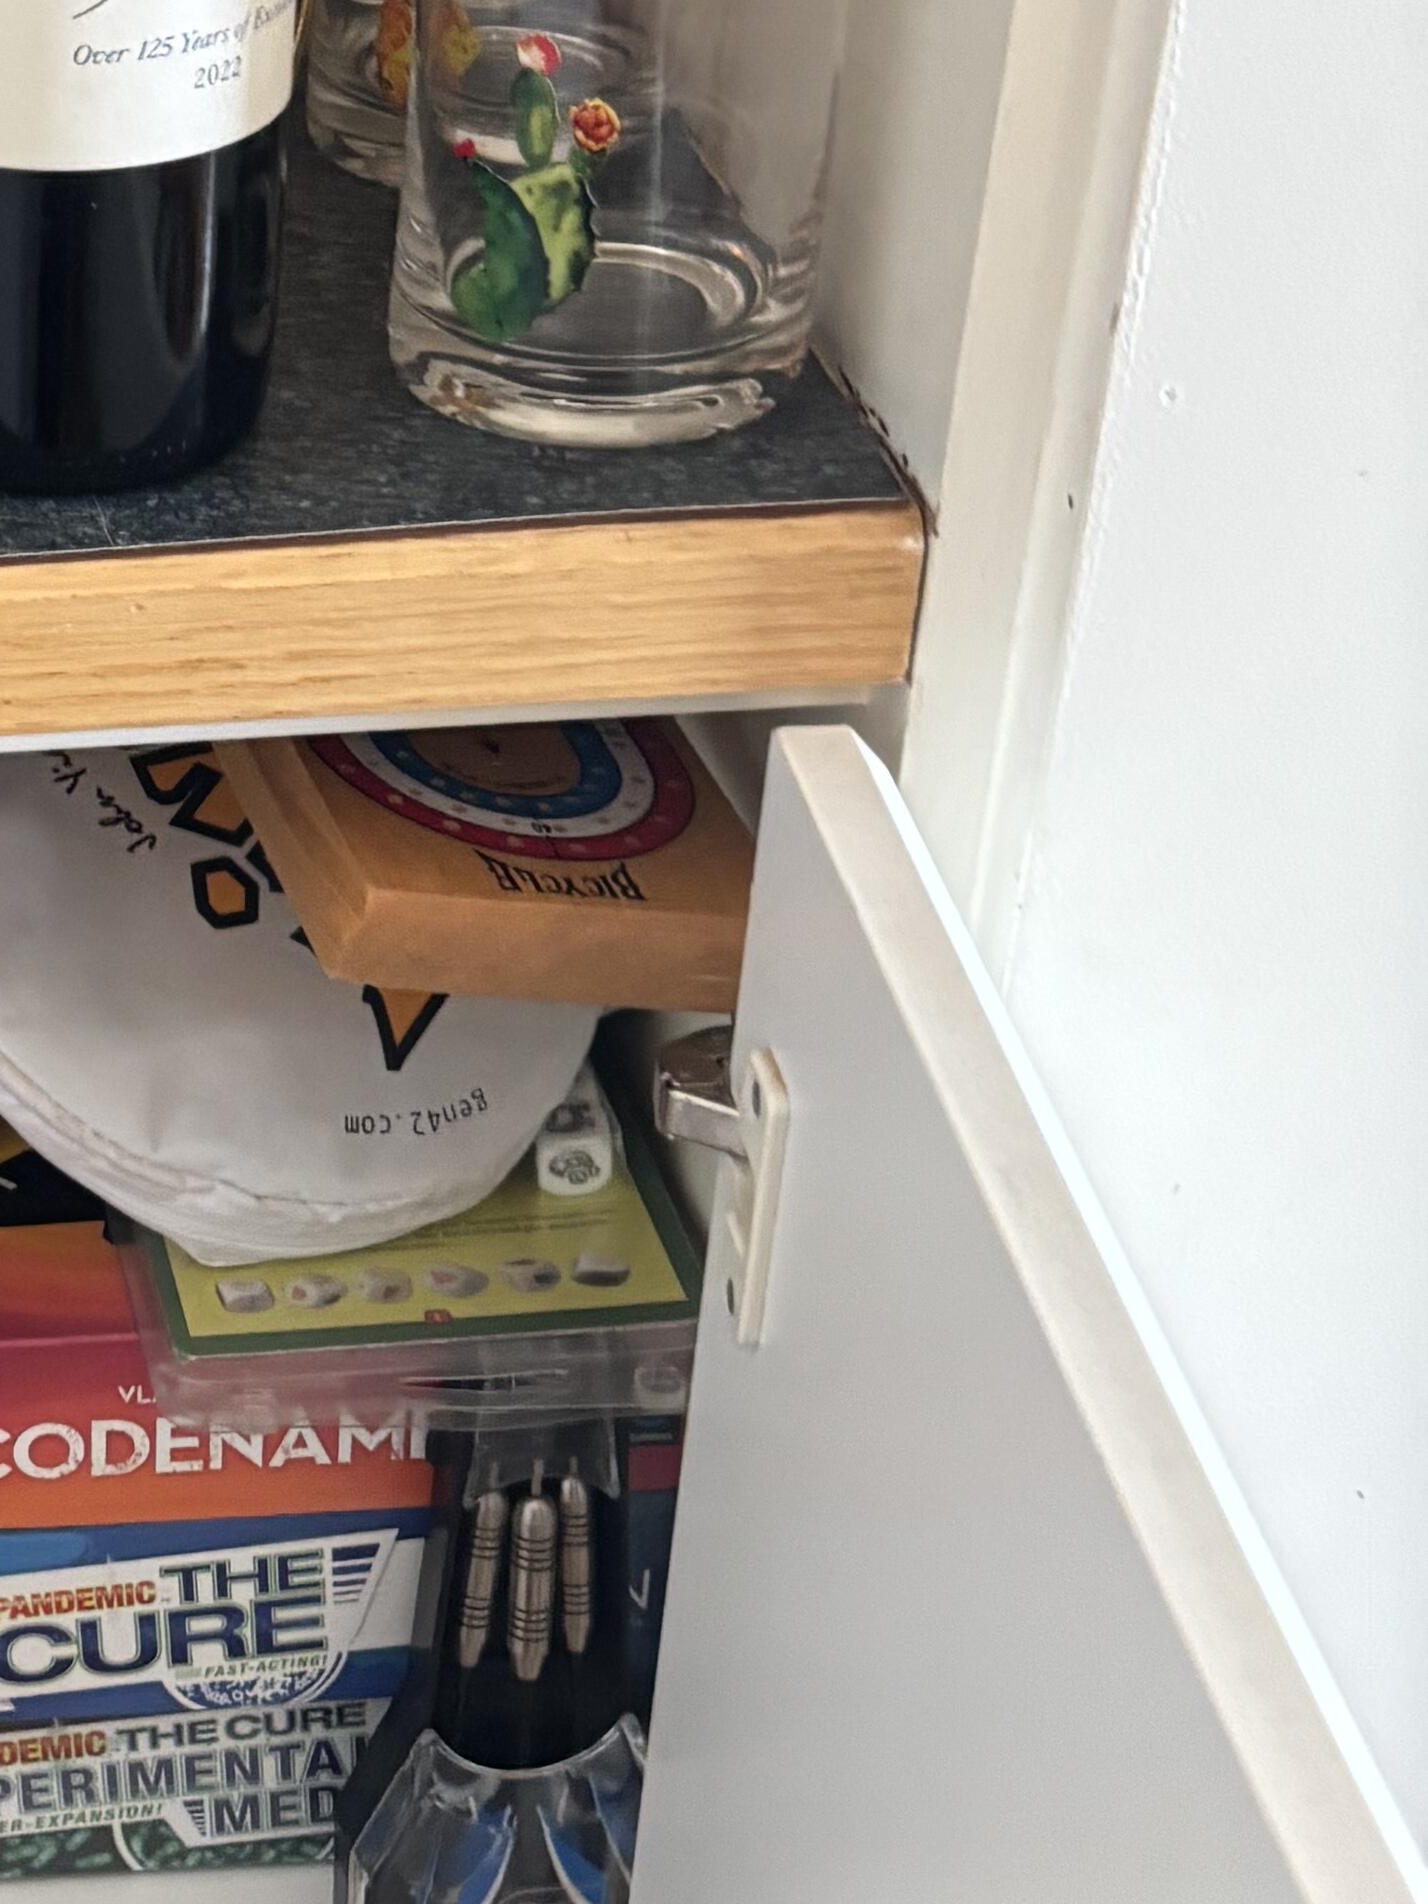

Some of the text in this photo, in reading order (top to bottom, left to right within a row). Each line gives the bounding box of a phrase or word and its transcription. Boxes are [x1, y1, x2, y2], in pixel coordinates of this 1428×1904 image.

[73, 44, 130, 66] Over
[137, 35, 176, 62] 125
[181, 26, 231, 55] Years
[194, 54, 243, 89] 2022
[472, 848, 647, 904] BICYCLE
[342, 1087, 489, 1137] gen42.com
[159, 1548, 326, 1604] THE
[203, 1654, 329, 1678] FAST-ACTING!
[117, 1720, 222, 1752] THE
[227, 1703, 366, 1742] CURE
